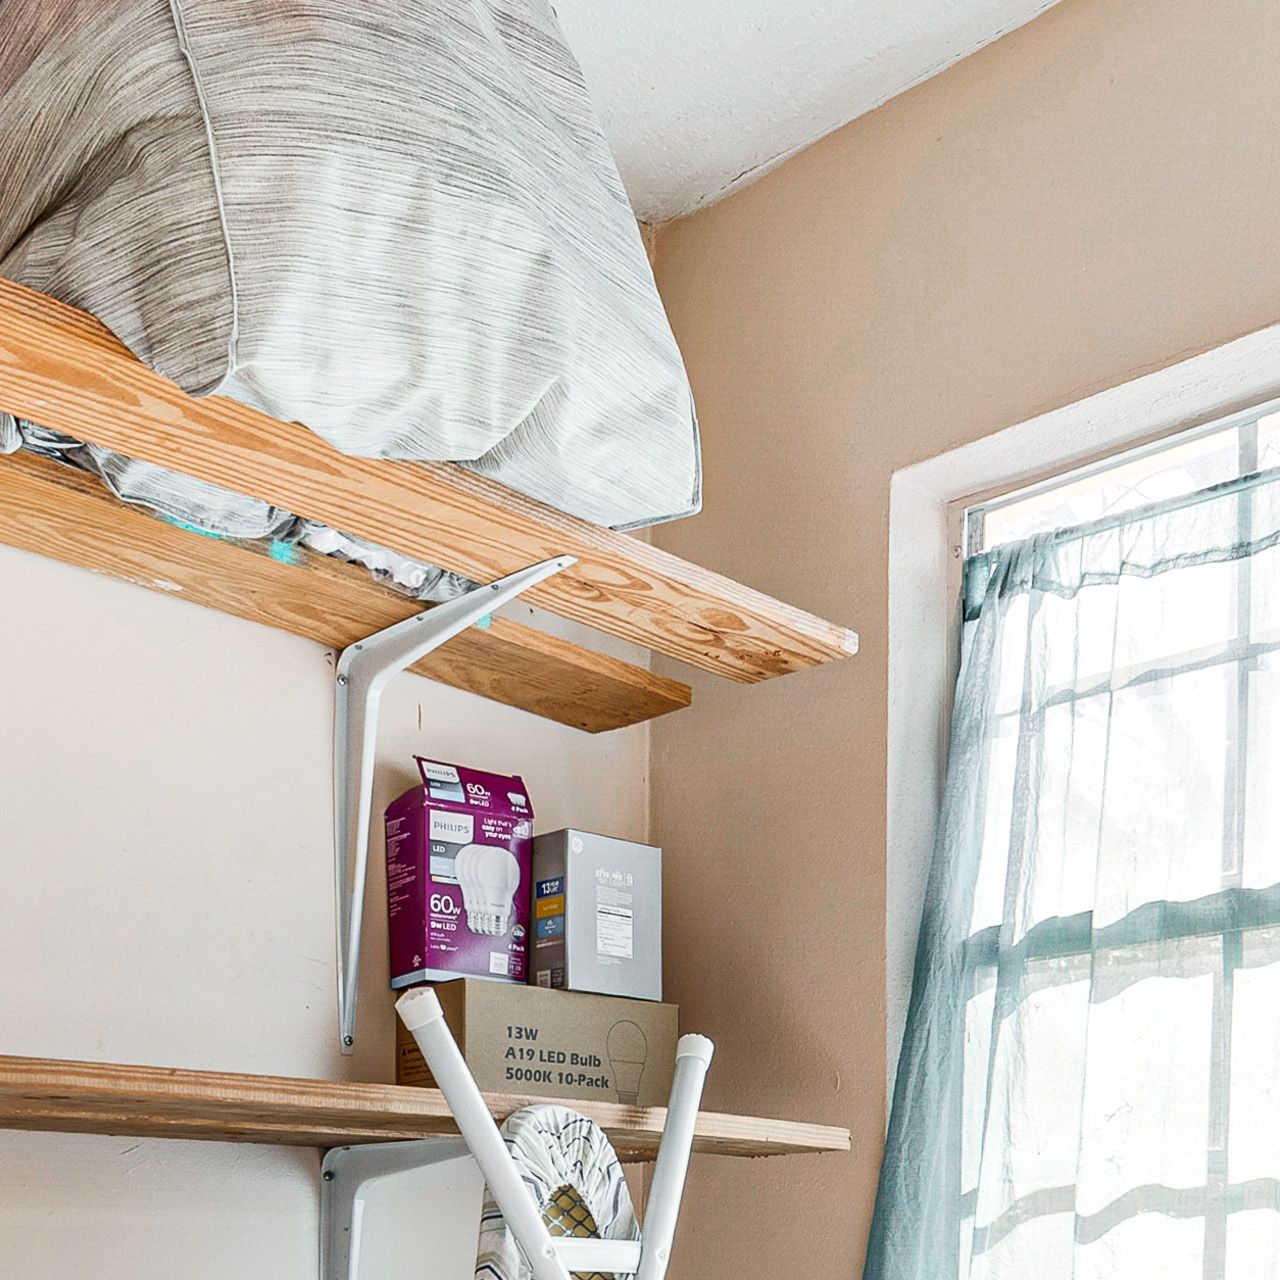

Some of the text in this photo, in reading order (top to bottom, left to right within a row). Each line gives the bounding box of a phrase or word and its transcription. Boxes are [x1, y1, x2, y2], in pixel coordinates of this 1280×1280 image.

[434, 821, 469, 834] PHILIPS
[432, 845, 446, 853] LED
[443, 922, 457, 931] LED
[507, 1026, 538, 1041] 13W
[505, 1047, 601, 1067] A19 LED Bulb
[505, 1067, 609, 1088] 5000K 10-Pack
